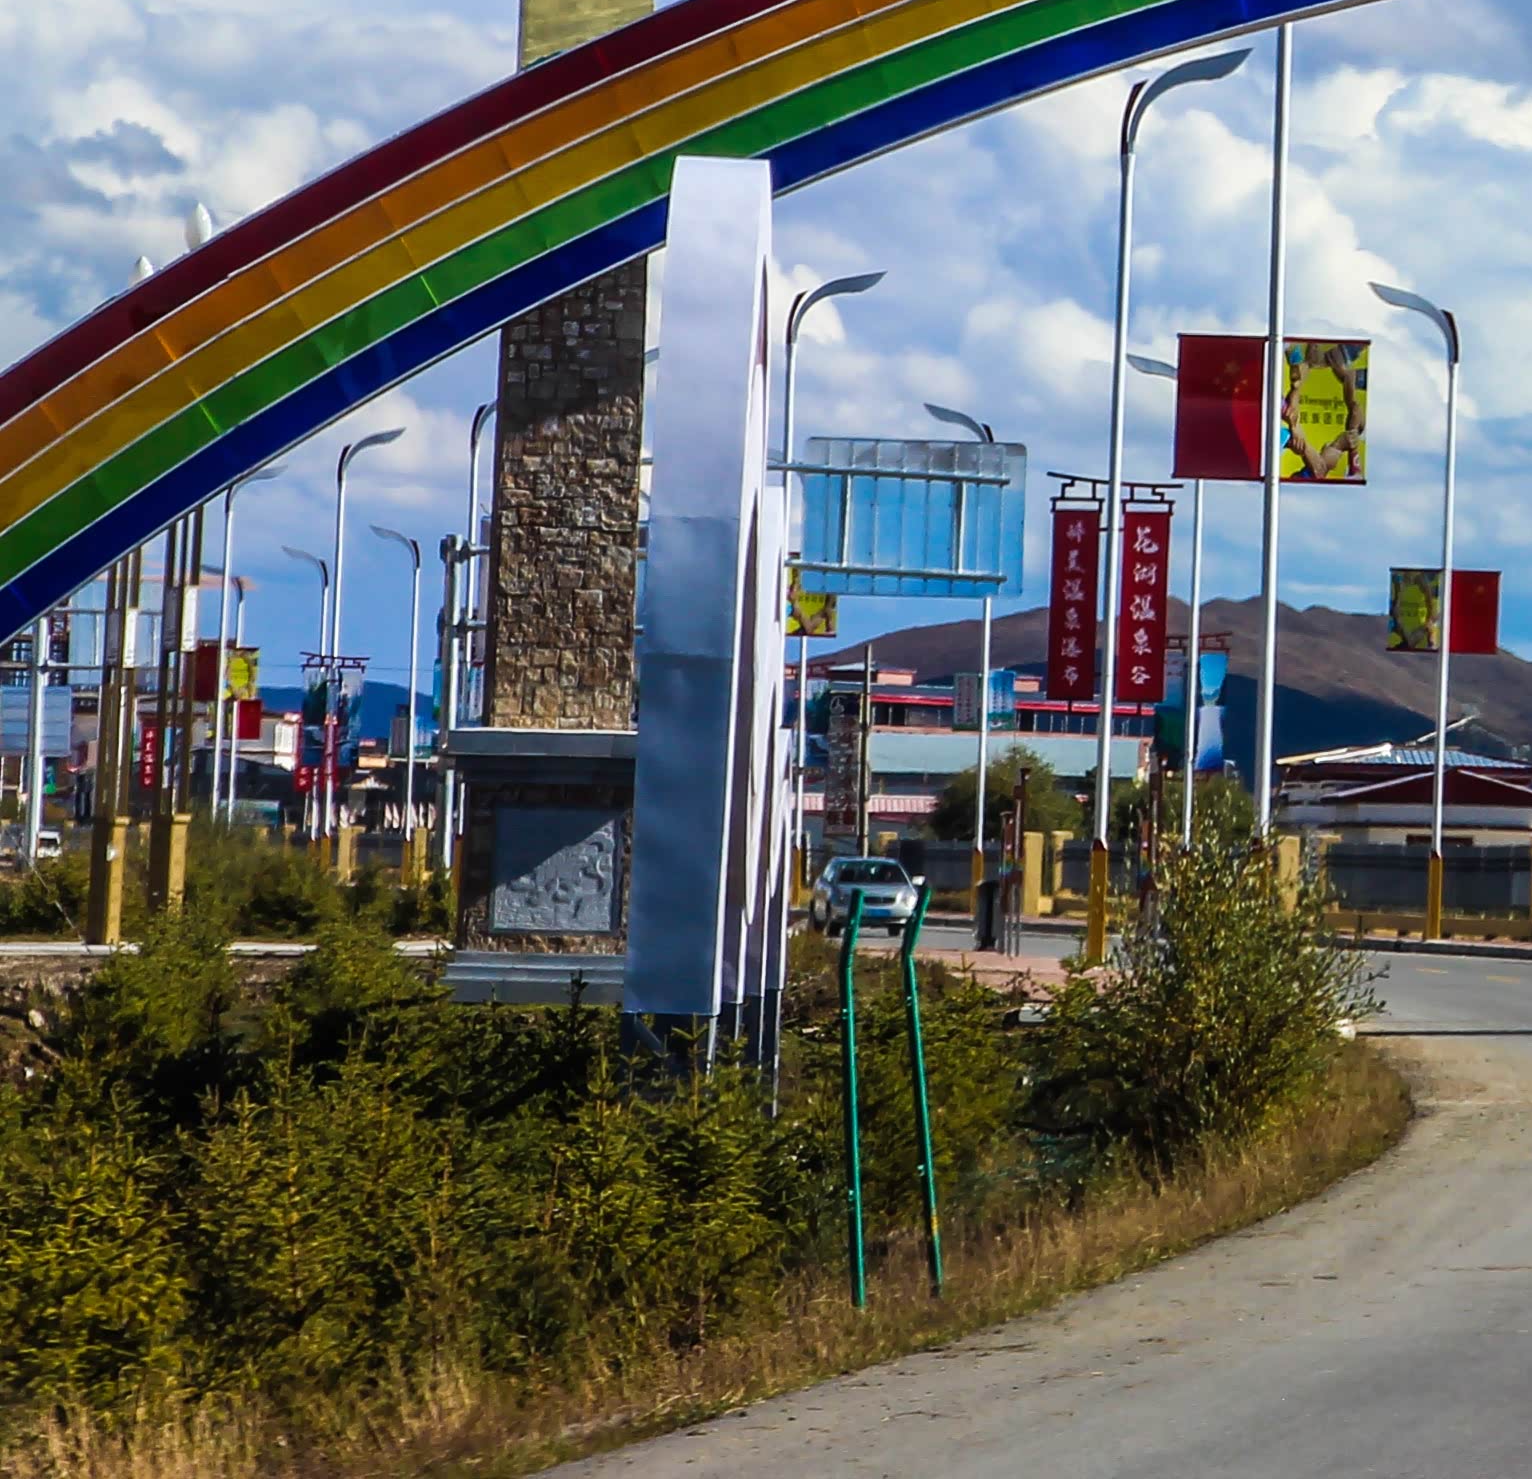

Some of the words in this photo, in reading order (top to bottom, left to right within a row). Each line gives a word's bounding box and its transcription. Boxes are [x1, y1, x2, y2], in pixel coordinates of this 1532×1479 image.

[1128, 525, 1159, 686] 花湖温泉谷
